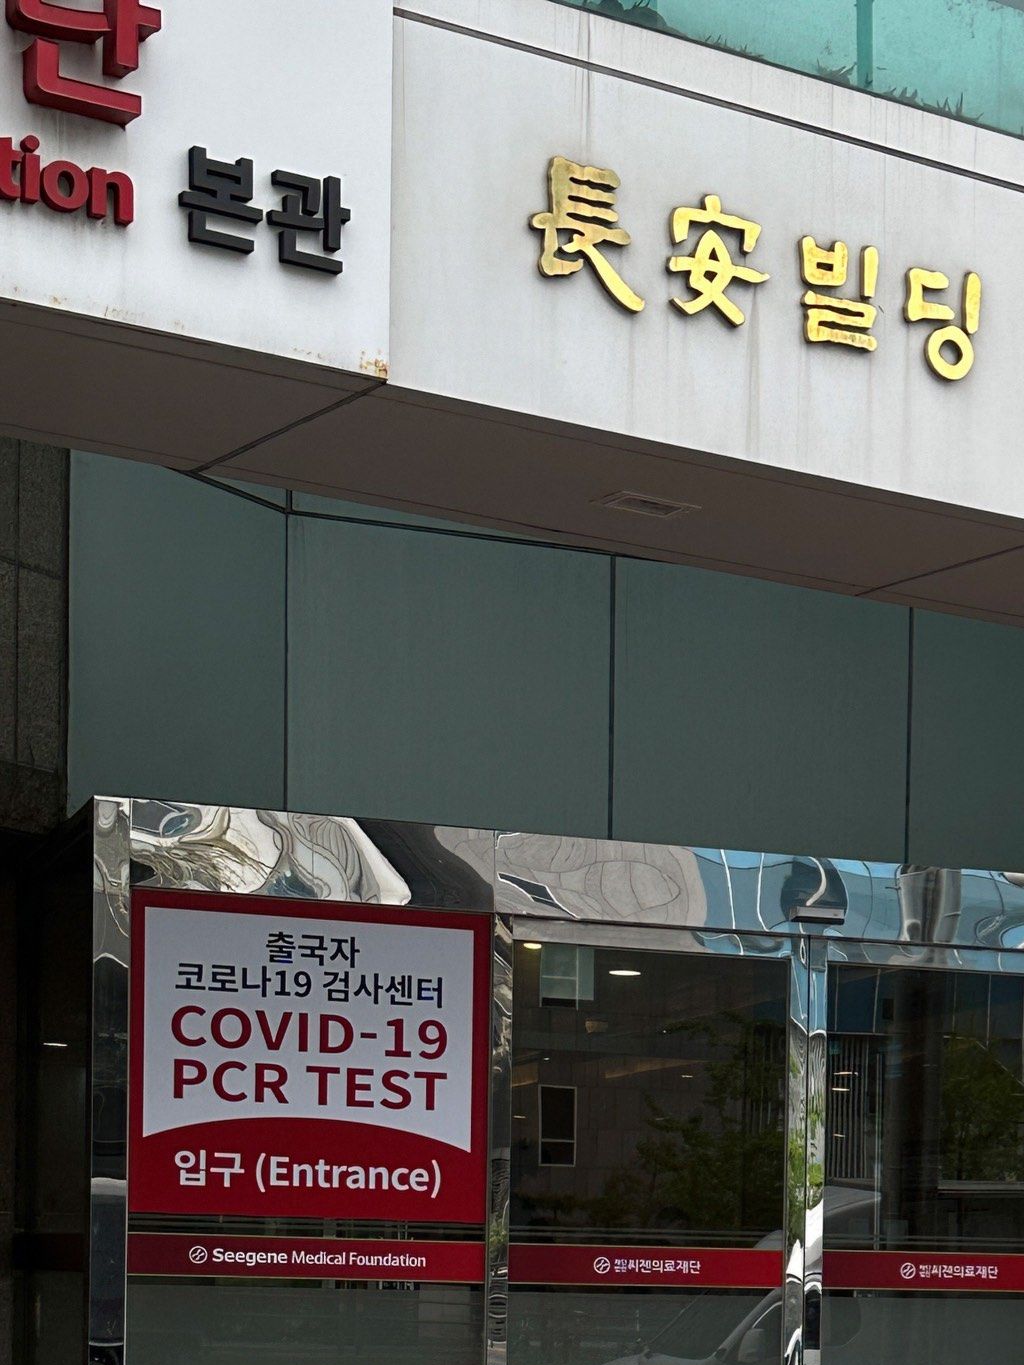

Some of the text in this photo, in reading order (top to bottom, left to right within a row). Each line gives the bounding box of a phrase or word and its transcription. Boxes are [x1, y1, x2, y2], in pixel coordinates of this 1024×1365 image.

[179, 145, 351, 275] 본관
[265, 932, 360, 969] 출국자
[175, 962, 443, 1008] 코로나19 검사센터
[171, 1005, 448, 1060] COVID-19
[173, 1058, 447, 1111] PCR TEST
[174, 1149, 441, 1198] 입구 (Entrance)
[212, 1248, 426, 1267] Seegene Medical Foundation
